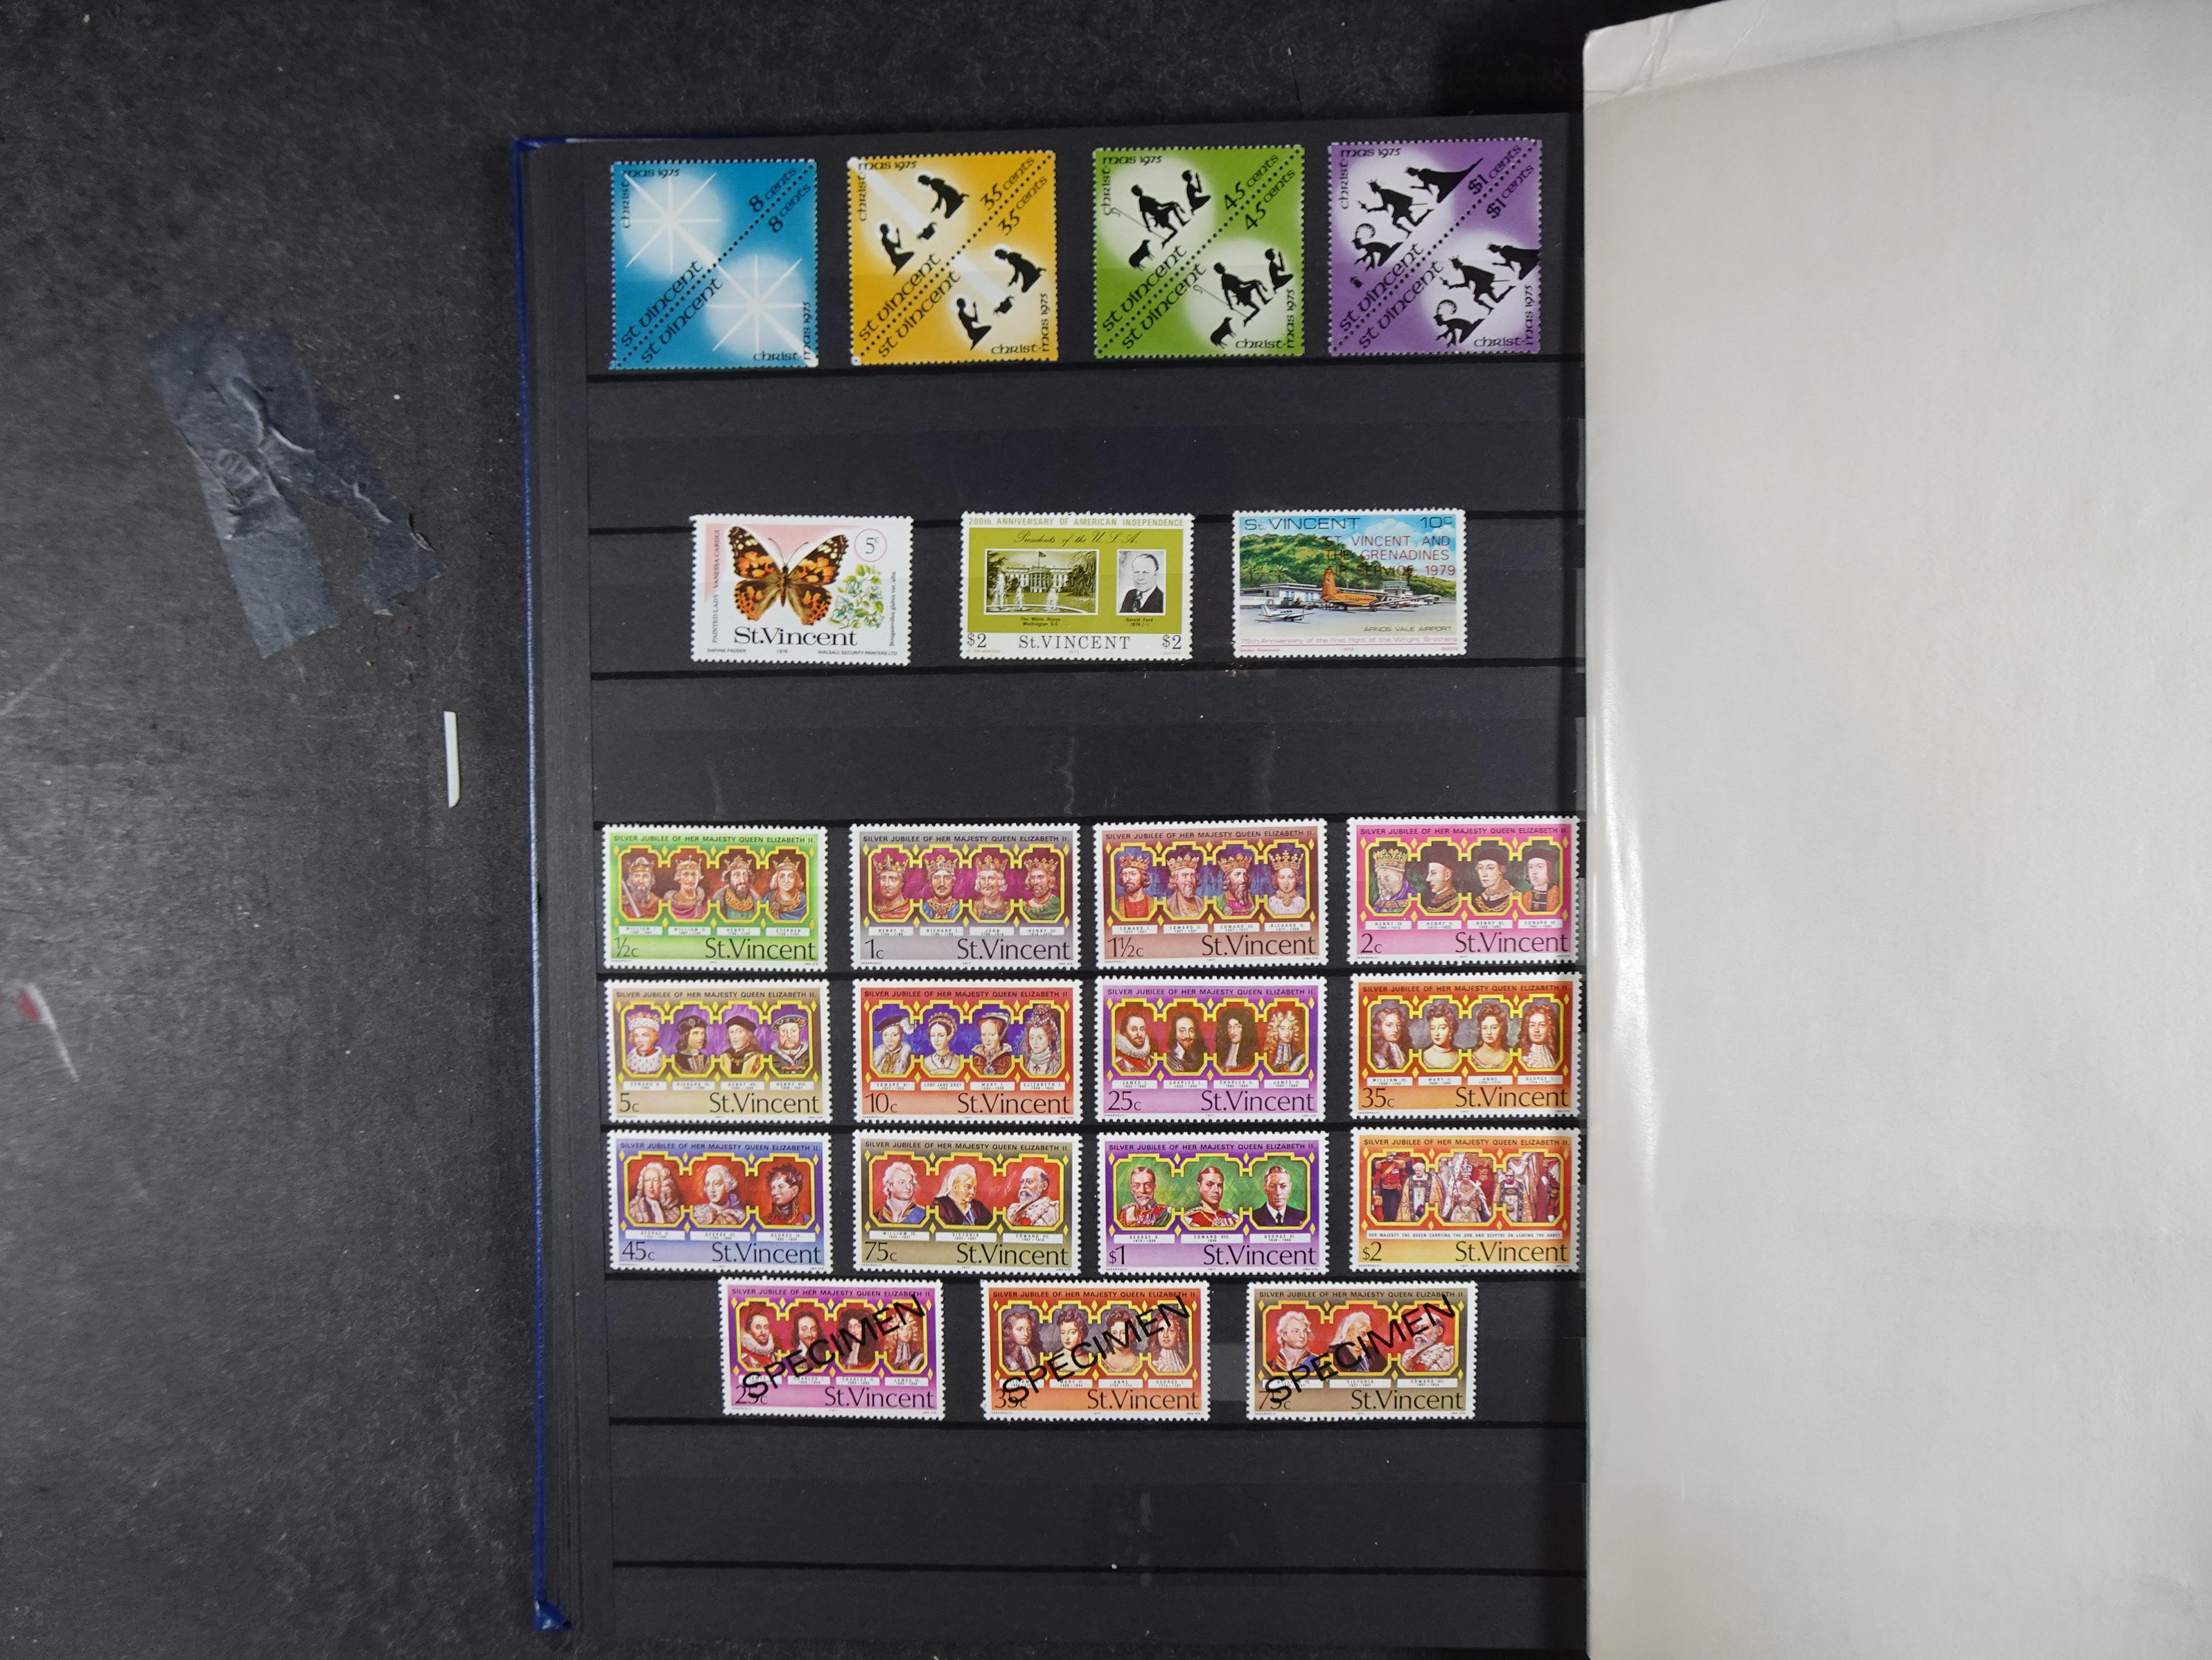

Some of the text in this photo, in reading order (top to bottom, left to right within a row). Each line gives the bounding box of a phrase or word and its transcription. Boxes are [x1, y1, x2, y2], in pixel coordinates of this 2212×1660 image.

[895, 160, 917, 171] 1975
[1468, 145, 1523, 195] $1 cents
[750, 168, 796, 212] 8 cents
[980, 157, 1035, 210] 35 cents
[1223, 154, 1279, 211] 45 cents
[1487, 165, 1535, 219] $1 cents
[768, 184, 811, 233] 8 cents
[998, 177, 1048, 236] 35 cents
[1244, 170, 1295, 231] 45 cents
[1040, 293, 1051, 315] 1975
[1269, 518, 1360, 529] VINCENT
[1013, 531, 1055, 544] Presidents
[1061, 535, 1070, 546] of
[1075, 534, 1086, 543] the
[1327, 536, 1450, 546] ST VINCENT AND
[1326, 550, 1449, 560] THE GRENADINES
[1425, 565, 1455, 576] 1979
[734, 626, 857, 646] St.Vincent
[967, 632, 987, 648] $2
[1162, 635, 1181, 650] $2
[706, 937, 816, 960] St.Vincent
[865, 938, 1070, 959] 1c St.Vincent
[1202, 935, 1316, 957] St.Vincent
[1361, 932, 1569, 953] 2c St.Vincent
[620, 1092, 819, 1113] 5c St.Vincent
[865, 1092, 1070, 1114] 10c St.Vincent
[1108, 1090, 1314, 1111] 25c St.Vincent
[1362, 1087, 1569, 1107] 35c St.Vincent
[622, 1241, 821, 1264] 45c St.Vincent
[865, 1241, 1069, 1265] 75c St.Vincent
[1109, 1244, 1316, 1264] $1 St.Vincent
[1362, 1240, 1567, 1262] $2 St.Vincent
[742, 1294, 925, 1398] SPECIMEN
[1003, 1296, 1190, 1404] SPECIMEN
[1265, 1294, 1455, 1403] SPECIMEN
[825, 1387, 934, 1408] St.Vincent
[1087, 1389, 1199, 1409] St.Vincent
[1352, 1389, 1463, 1410] St.Vincent
